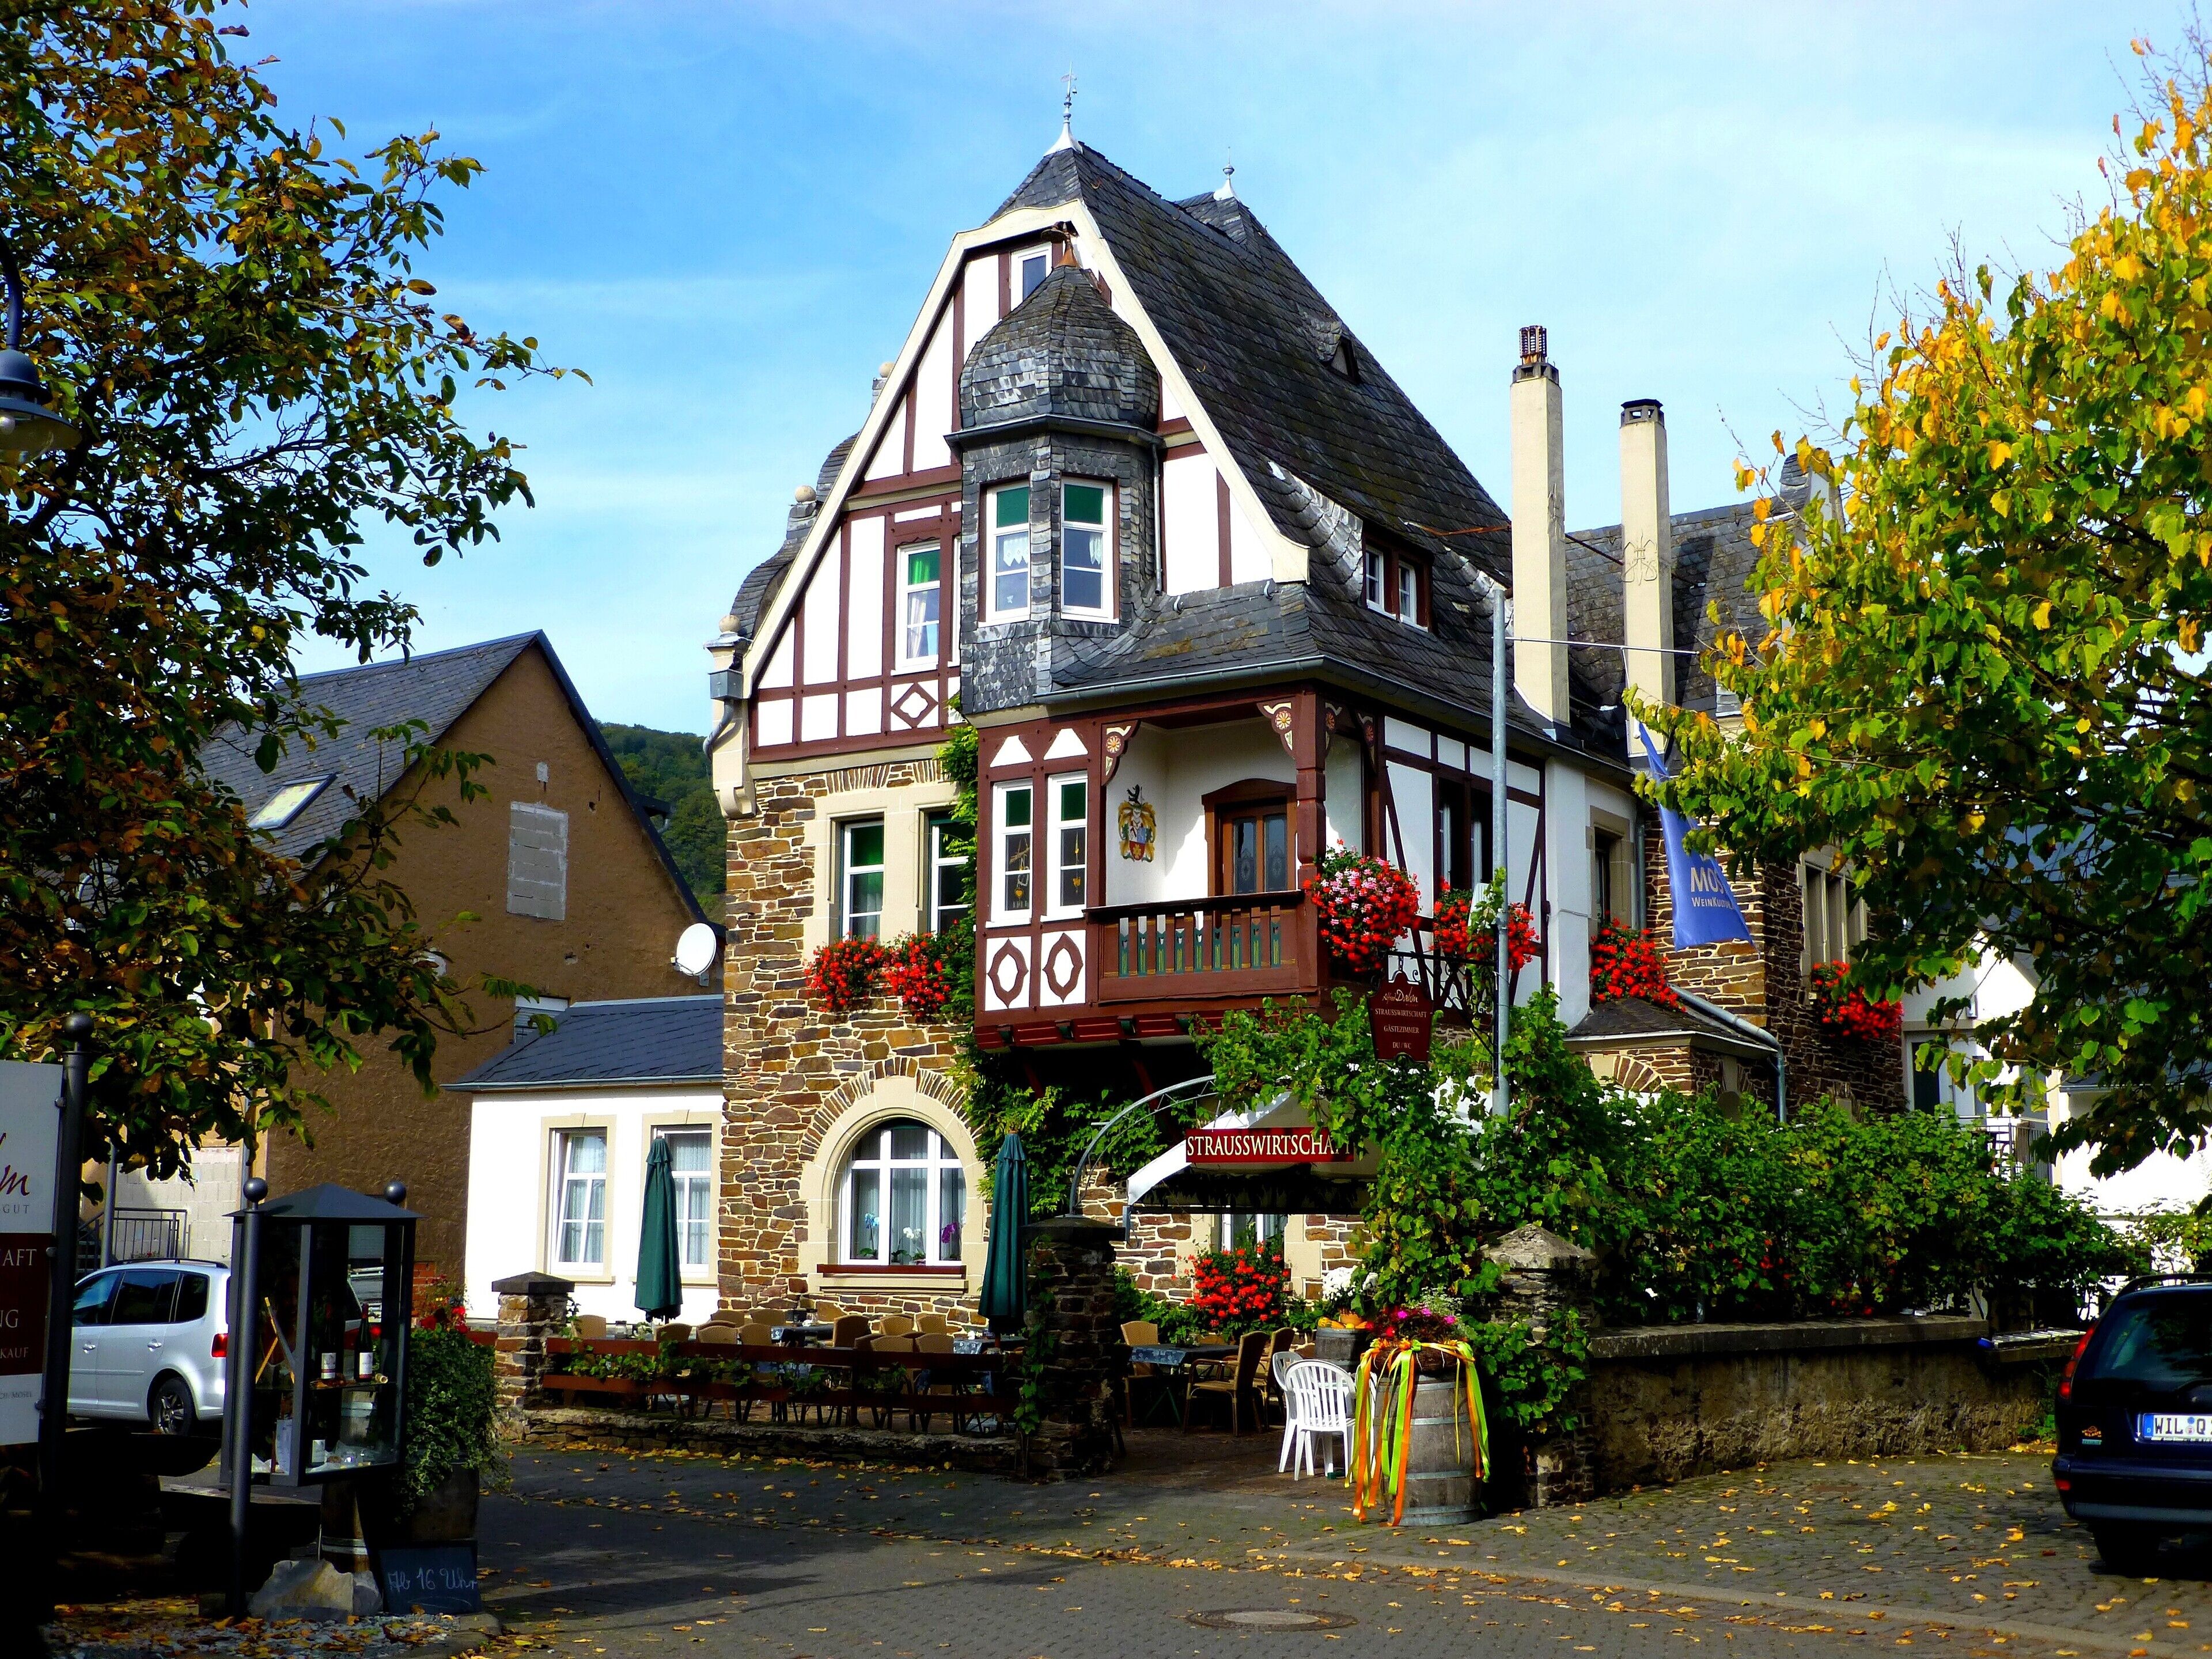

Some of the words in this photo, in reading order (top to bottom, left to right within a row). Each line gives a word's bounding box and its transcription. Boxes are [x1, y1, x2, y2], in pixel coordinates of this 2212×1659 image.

[1375, 1008, 1427, 1017] STRAUSSWIRTSCHAFT
[1384, 1025, 1419, 1033] GÄSTEZIMMER
[1187, 1134, 1350, 1156] STRAUSSWIRTSCHA
[2154, 1418, 2184, 1434] WIL
[2196, 1418, 2212, 1435] Q
[416, 1566, 435, 1590] 16
